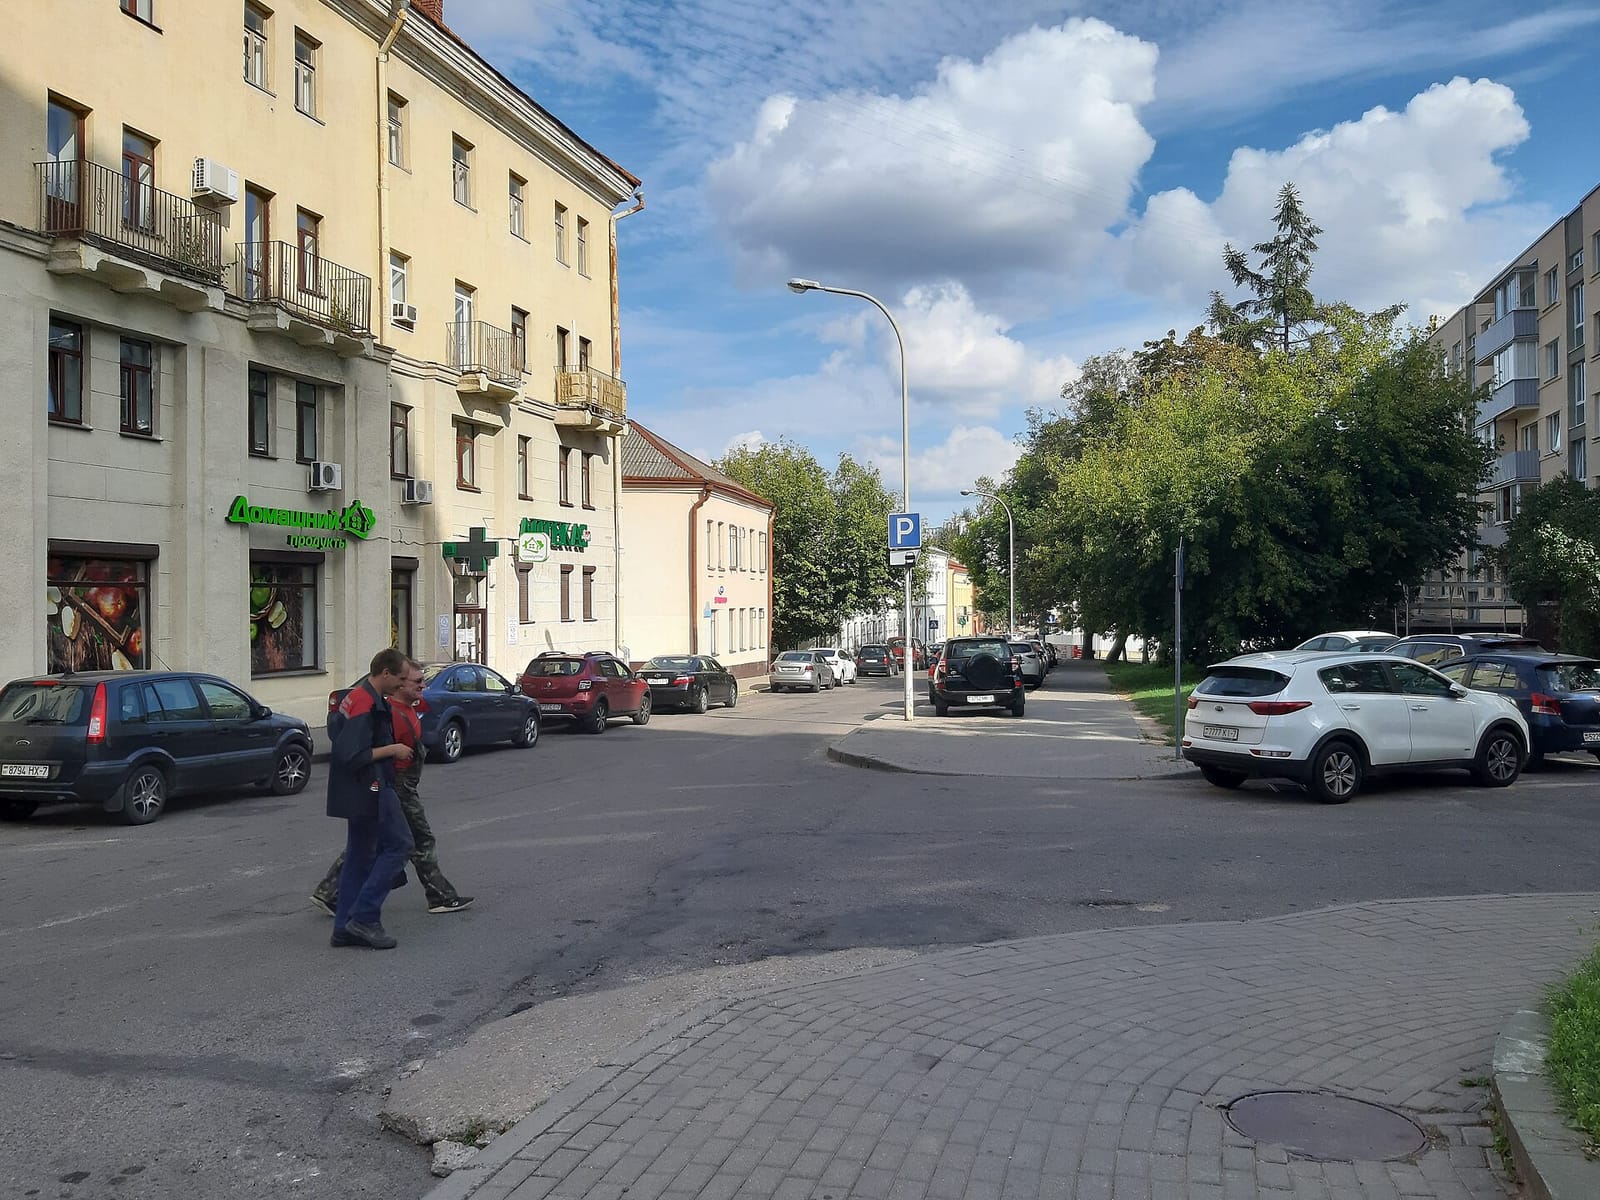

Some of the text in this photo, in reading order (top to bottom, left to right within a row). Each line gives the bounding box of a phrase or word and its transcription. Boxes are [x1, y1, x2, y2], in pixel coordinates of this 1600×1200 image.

[226, 495, 340, 530] Домашний
[288, 534, 347, 549] продукты
[897, 517, 914, 545] P
